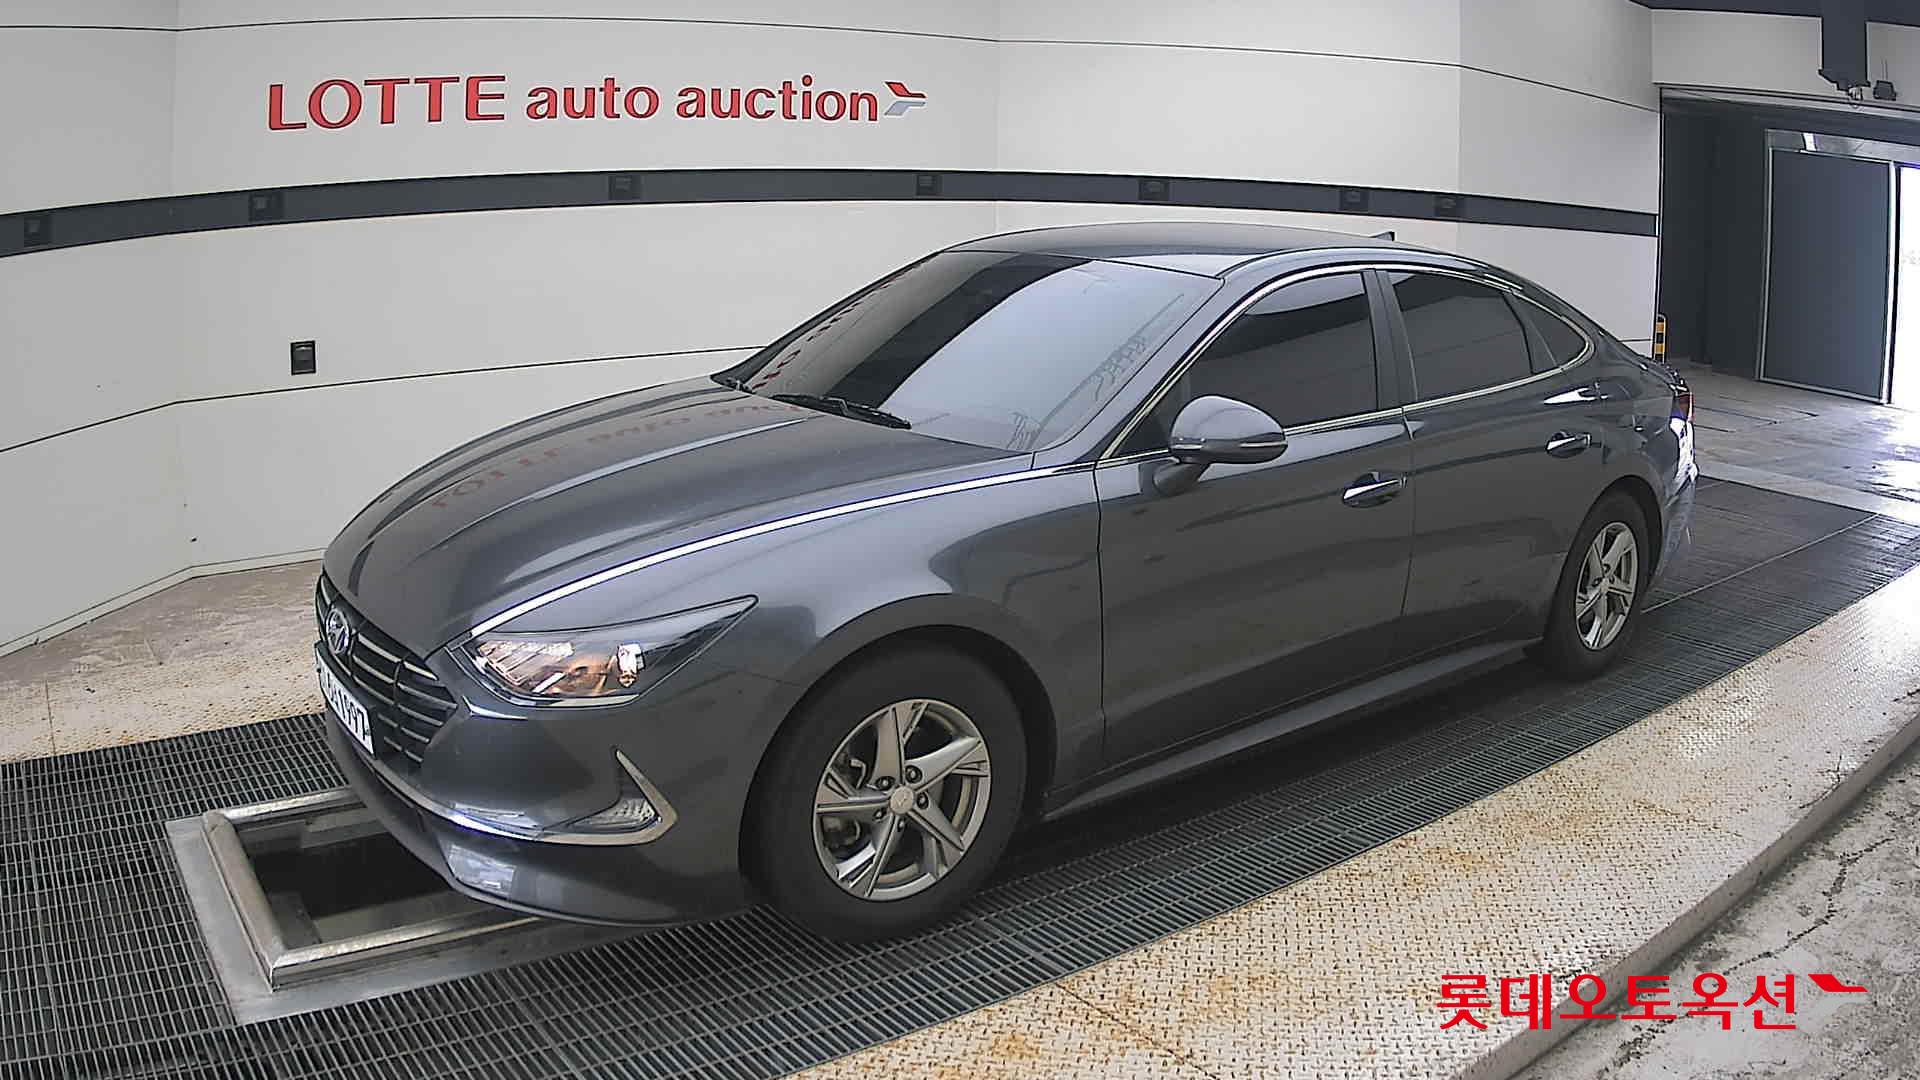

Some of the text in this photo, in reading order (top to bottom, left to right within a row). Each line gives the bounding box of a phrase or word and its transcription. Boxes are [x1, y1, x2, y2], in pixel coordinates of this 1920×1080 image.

[269, 75, 880, 131] LOTTE auto auction
